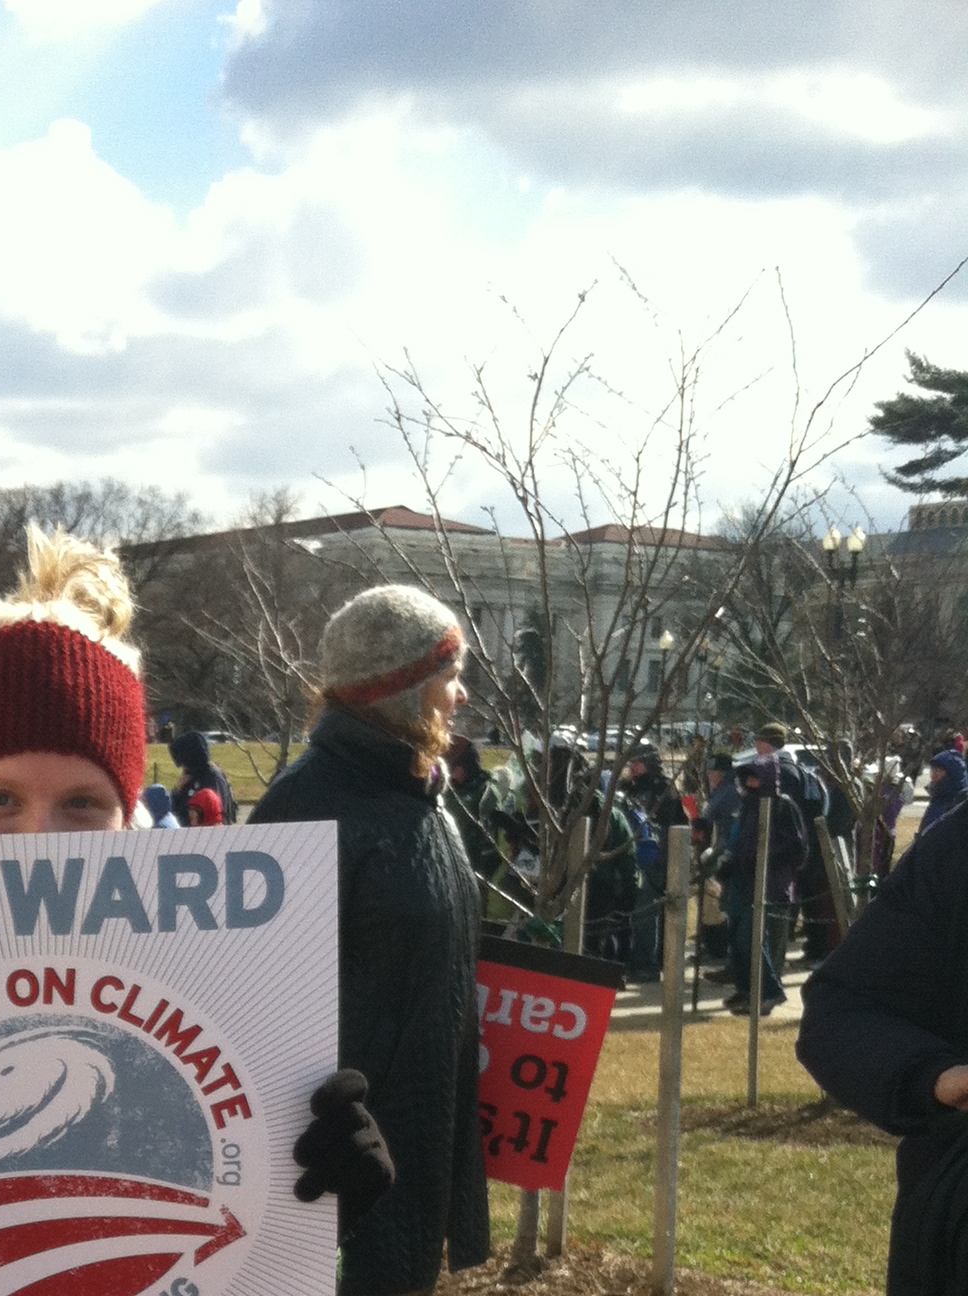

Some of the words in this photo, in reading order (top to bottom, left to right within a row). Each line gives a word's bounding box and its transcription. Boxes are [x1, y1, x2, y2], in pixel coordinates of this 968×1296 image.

[5, 967, 77, 1007] ON
[90, 974, 253, 1131] CLIMATE
[509, 1054, 570, 1103] to
